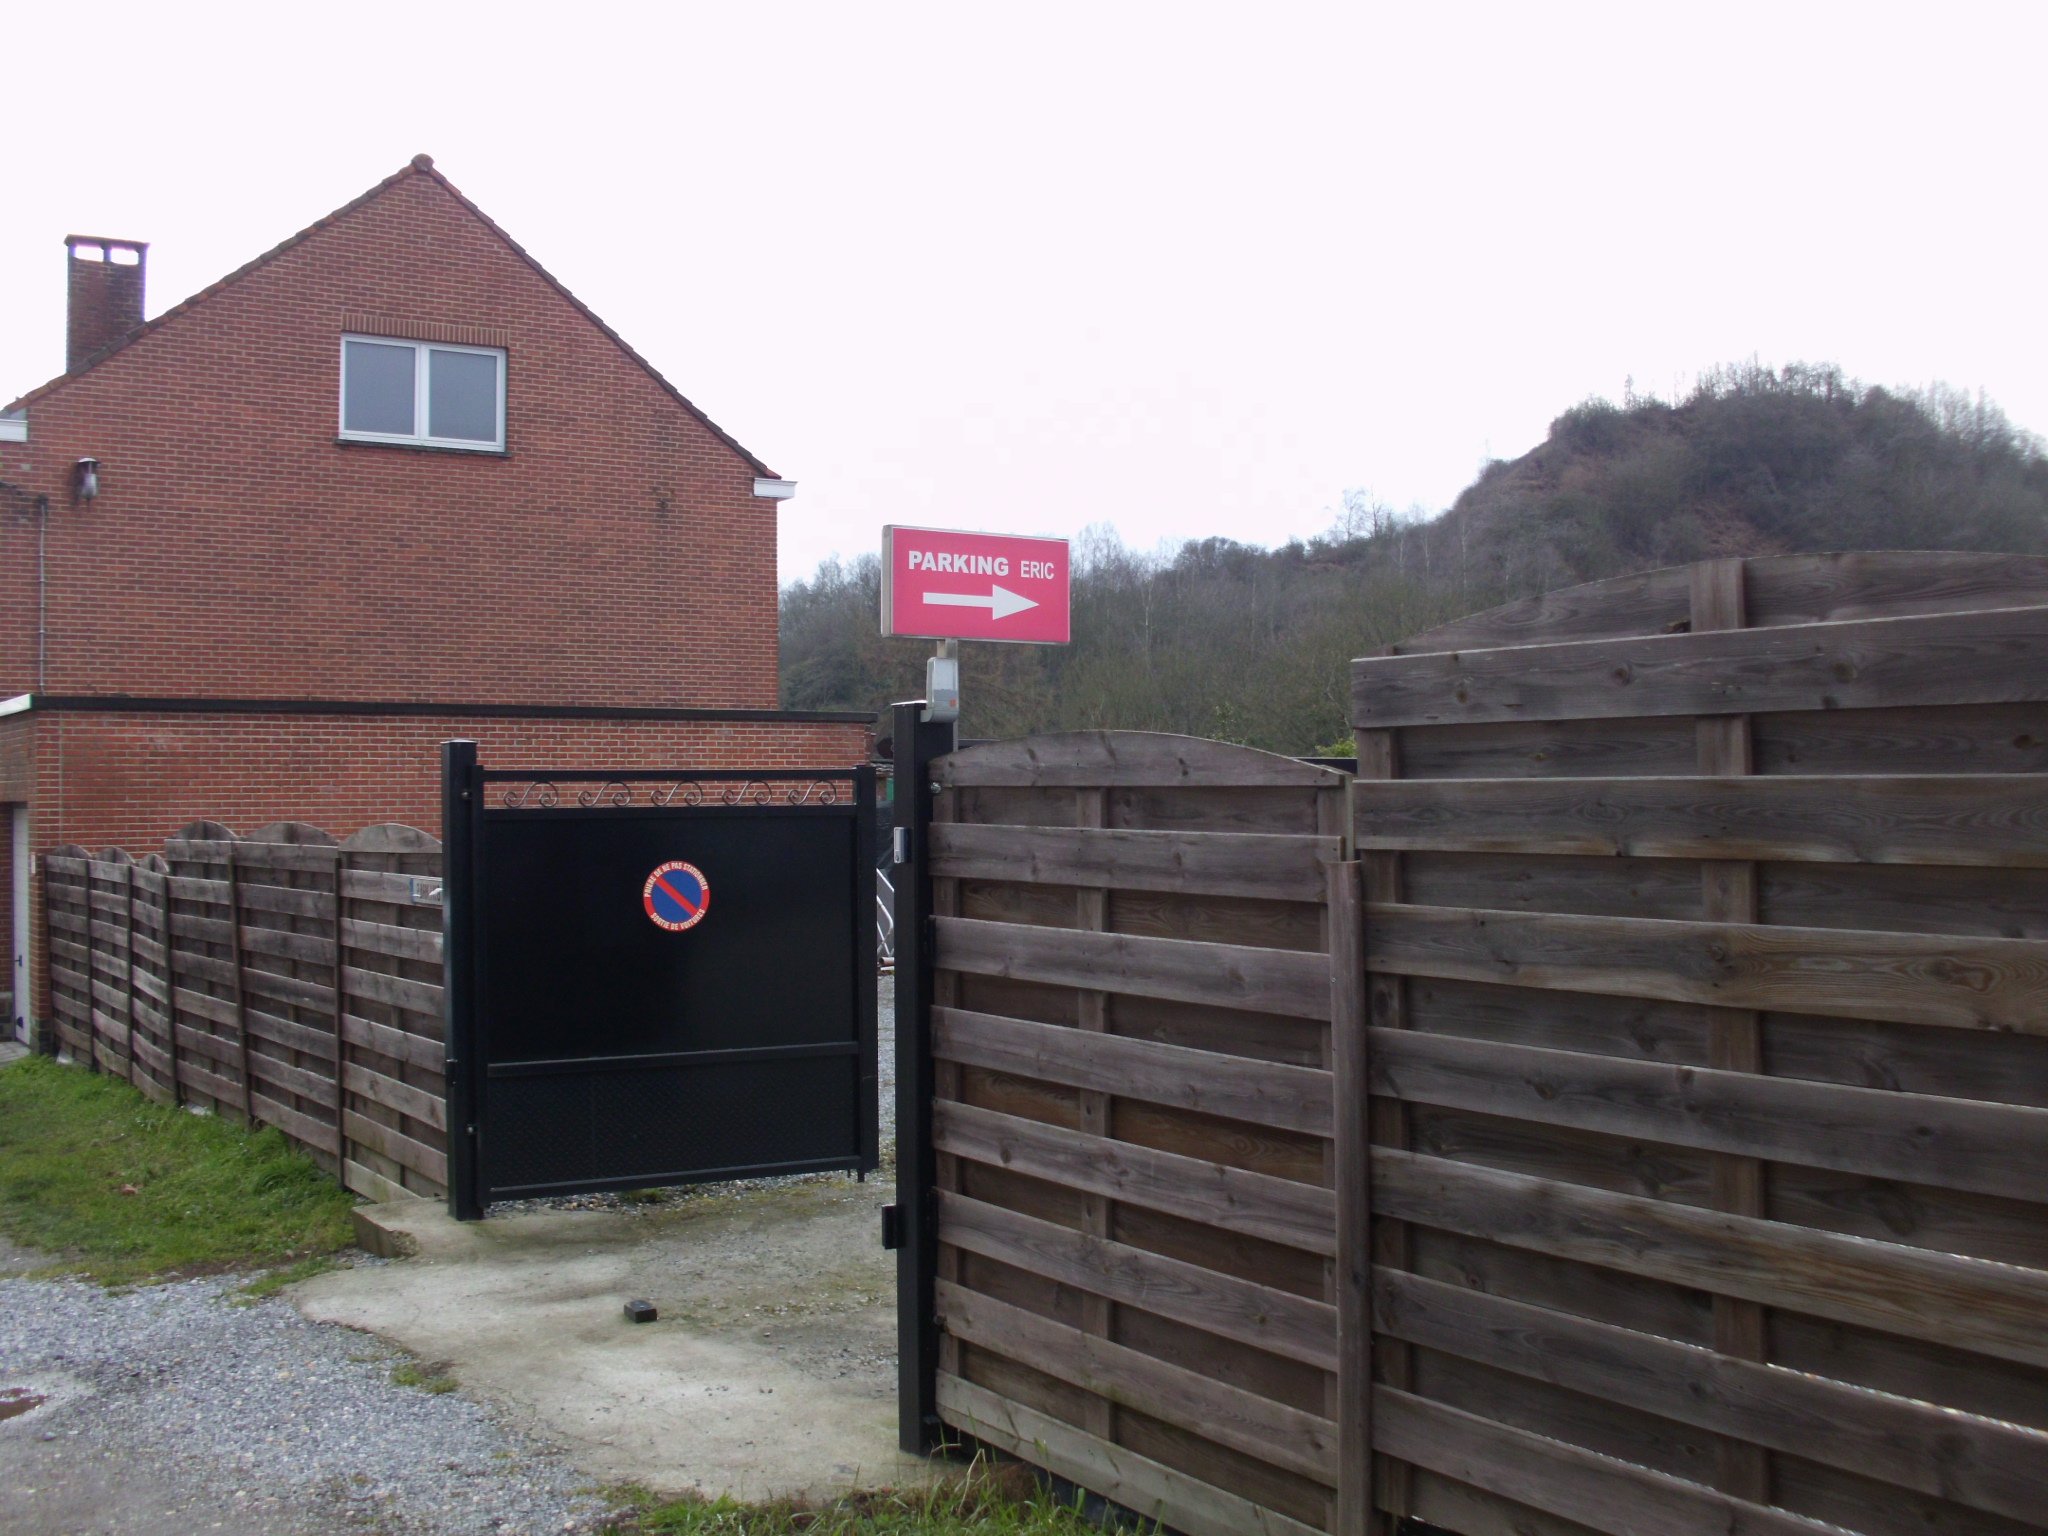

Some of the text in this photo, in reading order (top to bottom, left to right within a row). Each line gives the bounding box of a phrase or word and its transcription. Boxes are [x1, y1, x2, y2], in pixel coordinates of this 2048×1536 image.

[908, 550, 1055, 580] PARKING ERIC
[654, 868, 662, 877] DE
[662, 863, 670, 872] NE
[683, 863, 709, 891] STATIONNER
[650, 912, 670, 929] SORTIE
[679, 908, 706, 930] VOITURES
